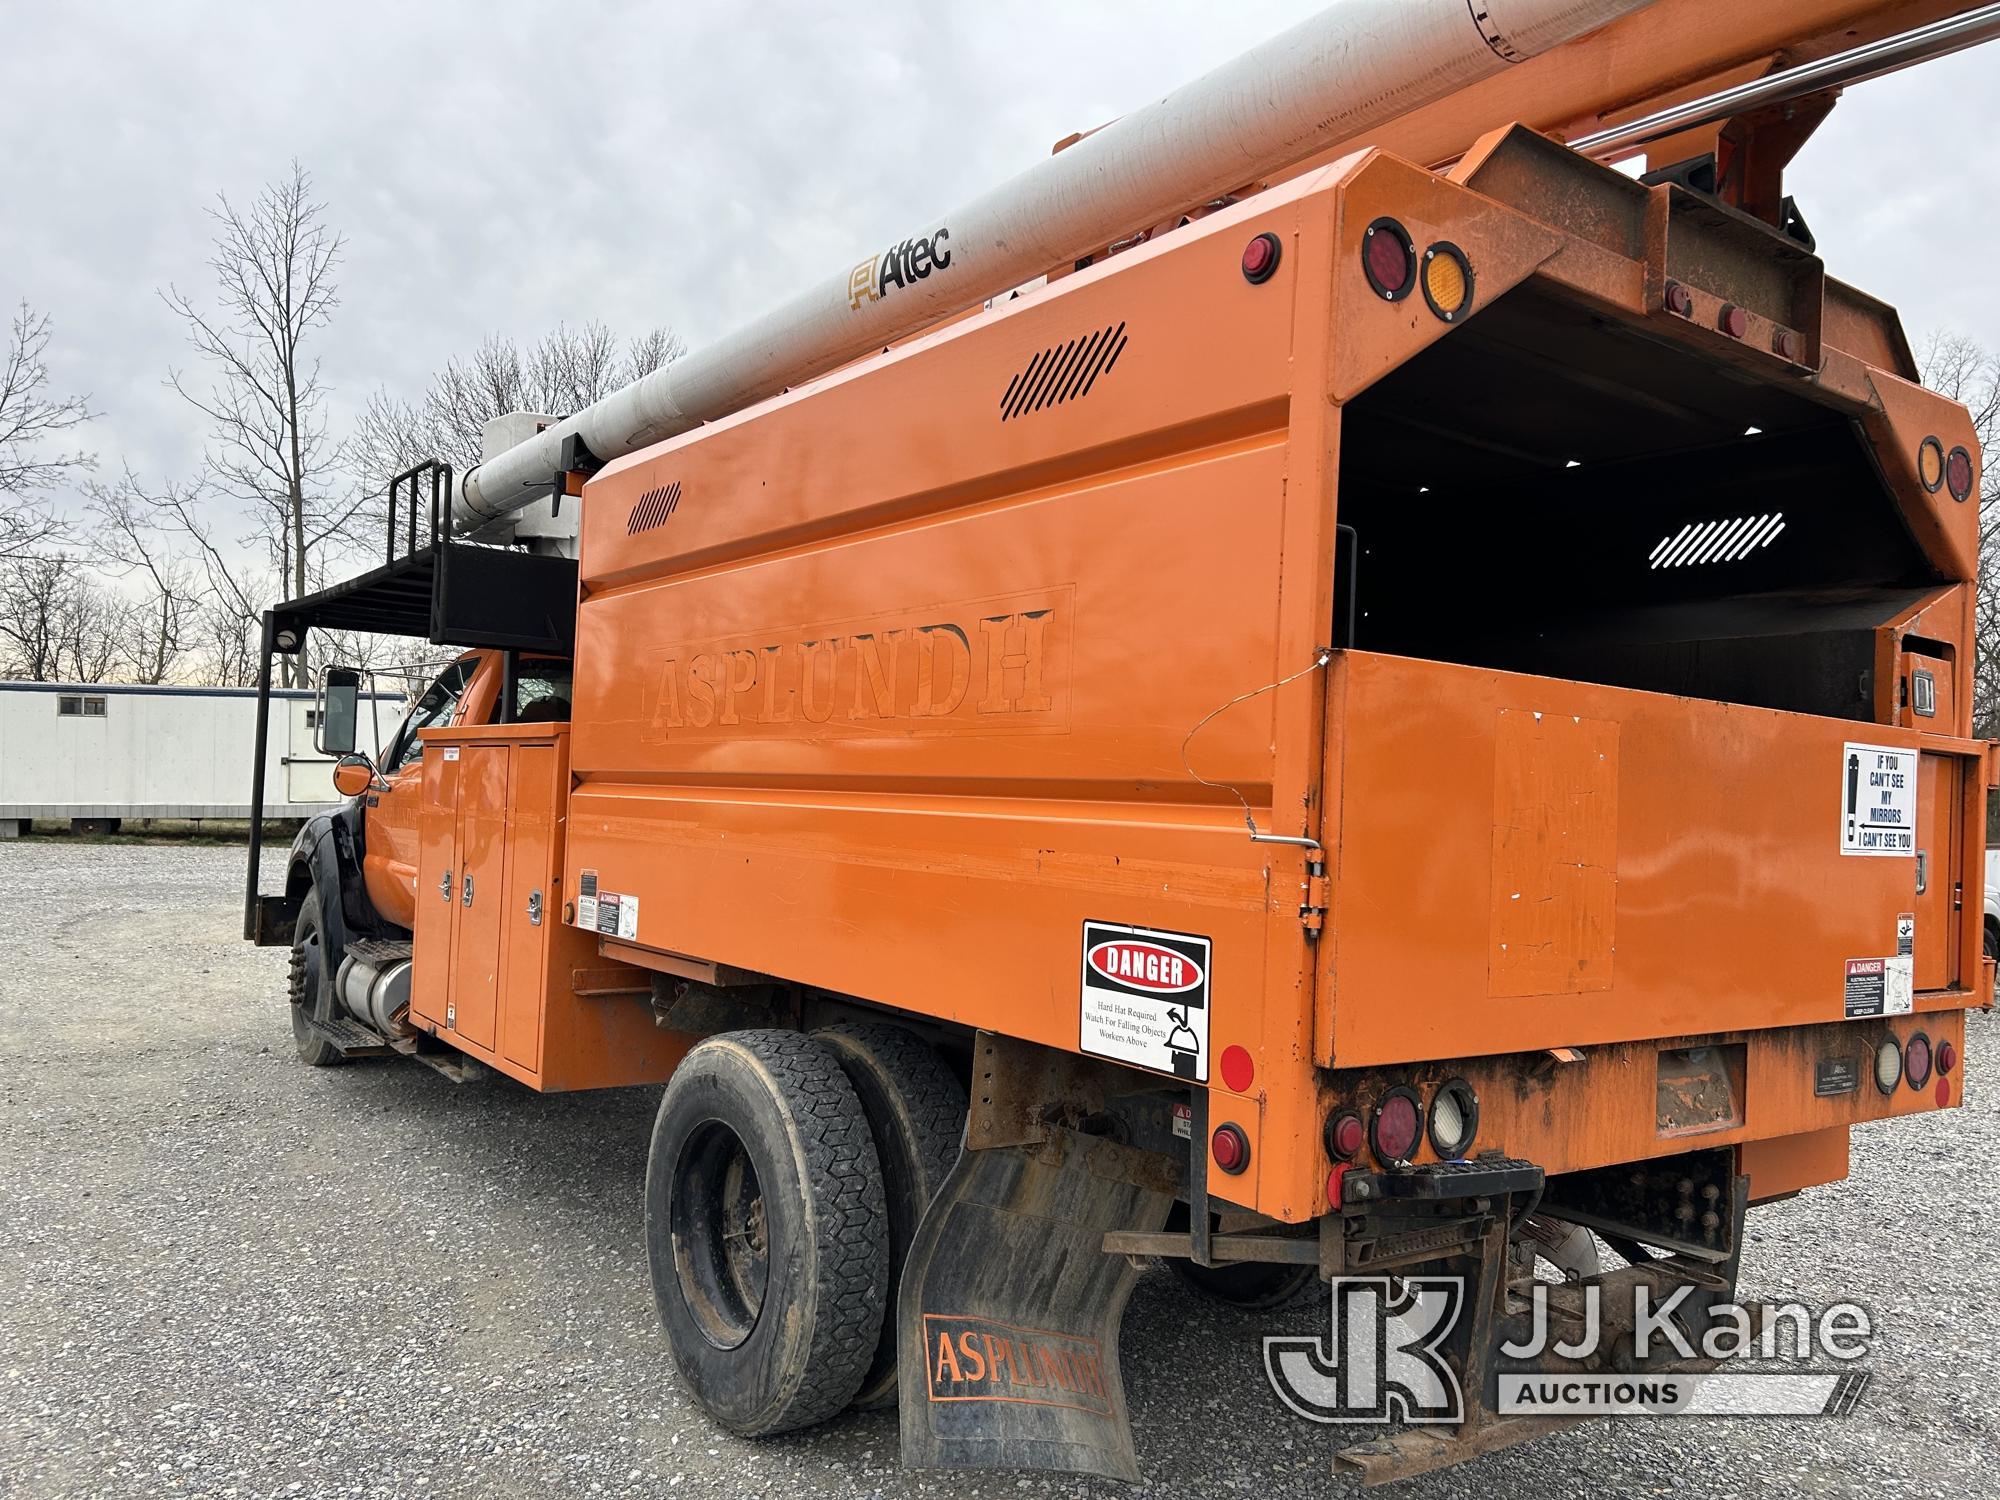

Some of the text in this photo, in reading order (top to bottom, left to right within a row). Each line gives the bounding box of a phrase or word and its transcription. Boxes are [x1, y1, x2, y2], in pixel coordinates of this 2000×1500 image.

[880, 228, 951, 297] Altec
[651, 608, 1056, 729] ASPLUNDH
[1877, 755, 1898, 770] IF YOU
[1870, 772, 1904, 788] CAN'T SEE
[1881, 790, 1892, 805] MY
[1870, 808, 1901, 823] MIRRORS
[1863, 832, 1883, 847] CAN'T
[1884, 833, 1896, 847] SEE
[1898, 834, 1911, 848] YOU
[1106, 946, 1183, 987] DANGER
[1856, 962, 1882, 973] DANGER
[1098, 1001, 1157, 1021] Hard Hat Required
[1085, 1012, 1167, 1038] Watch For Falling Objects
[1099, 1028, 1148, 1048] Workers Above
